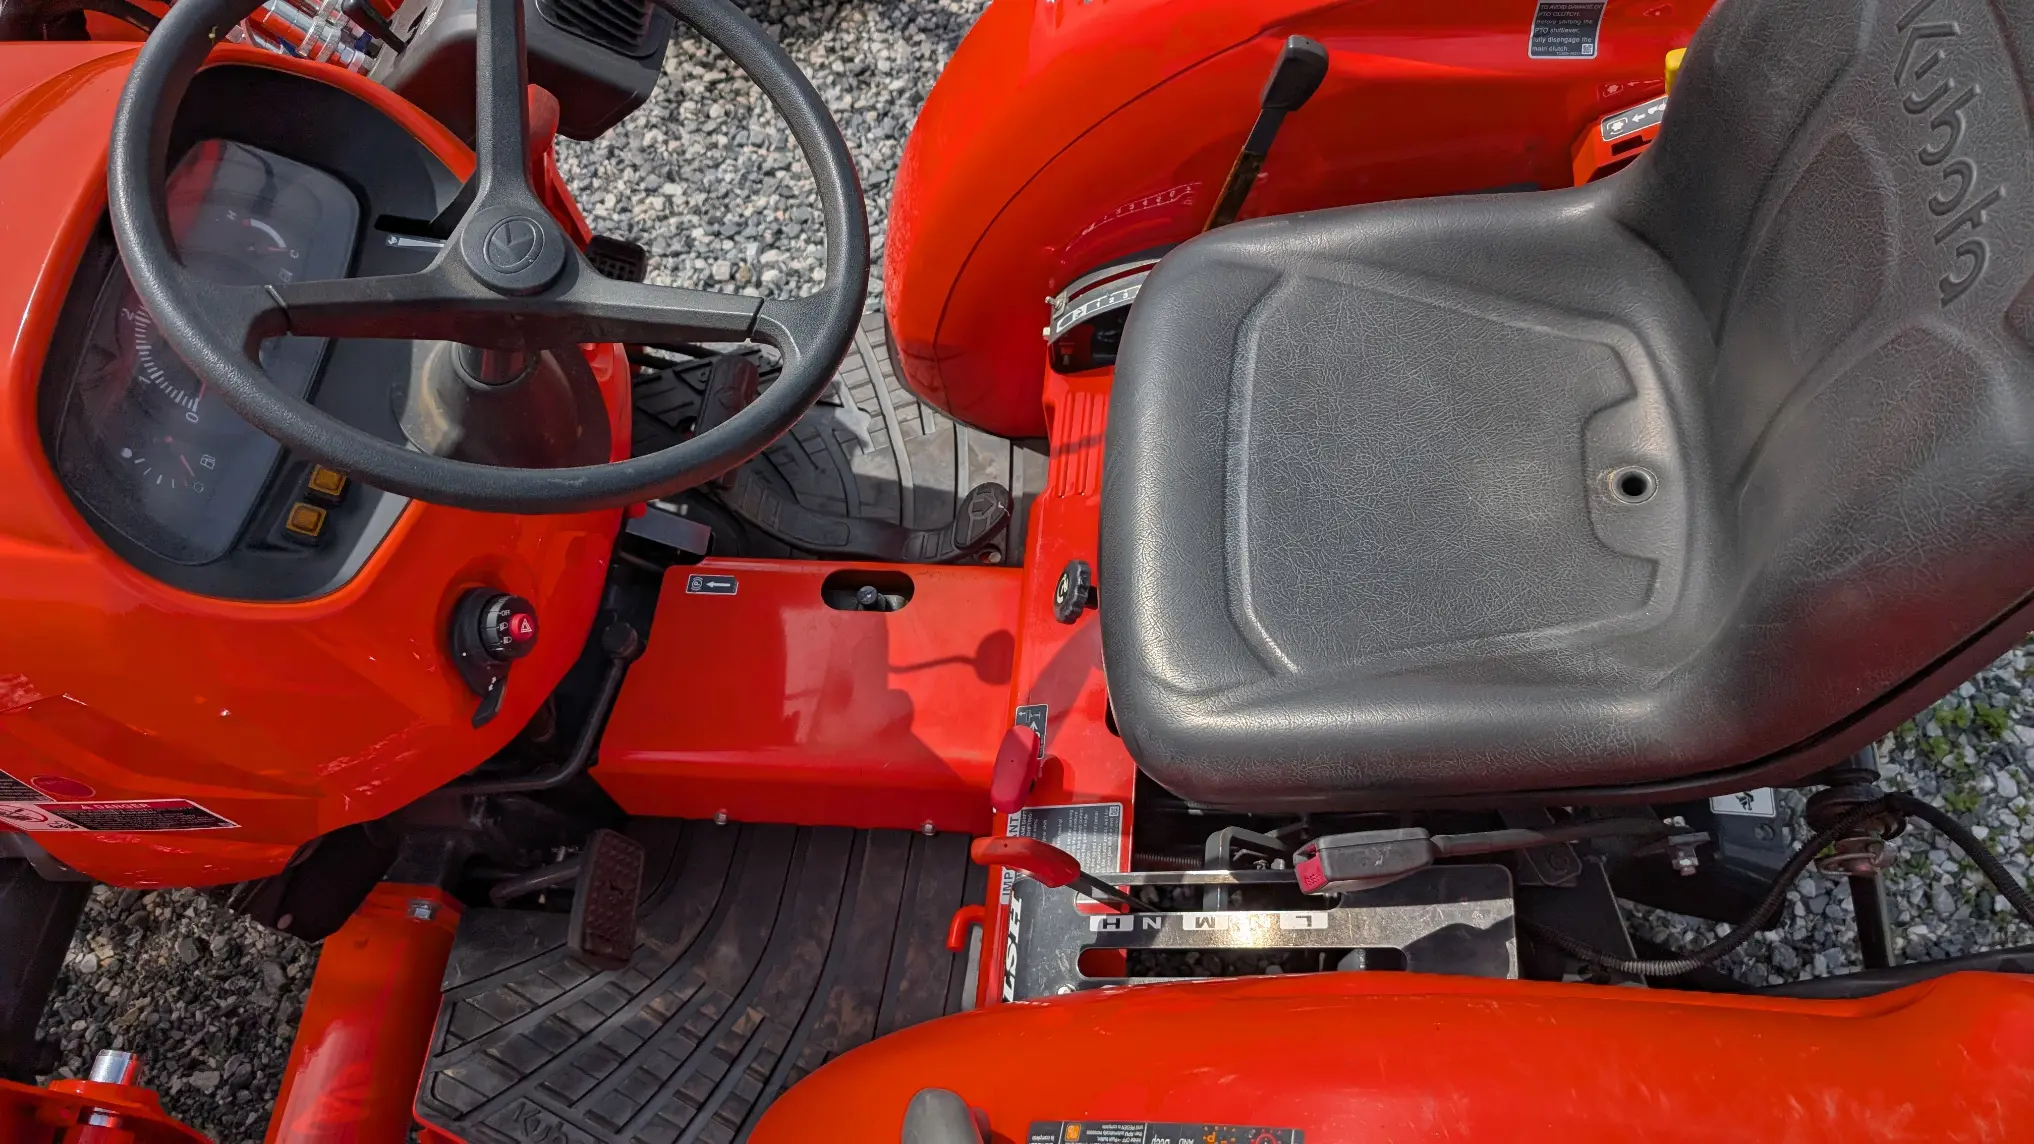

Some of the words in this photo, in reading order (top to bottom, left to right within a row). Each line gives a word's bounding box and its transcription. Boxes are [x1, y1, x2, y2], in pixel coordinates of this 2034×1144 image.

[1895, 0, 2005, 309] Kubota
[1103, 917, 1122, 930] H
[1142, 916, 1162, 930] N
[1195, 916, 1217, 929] M
